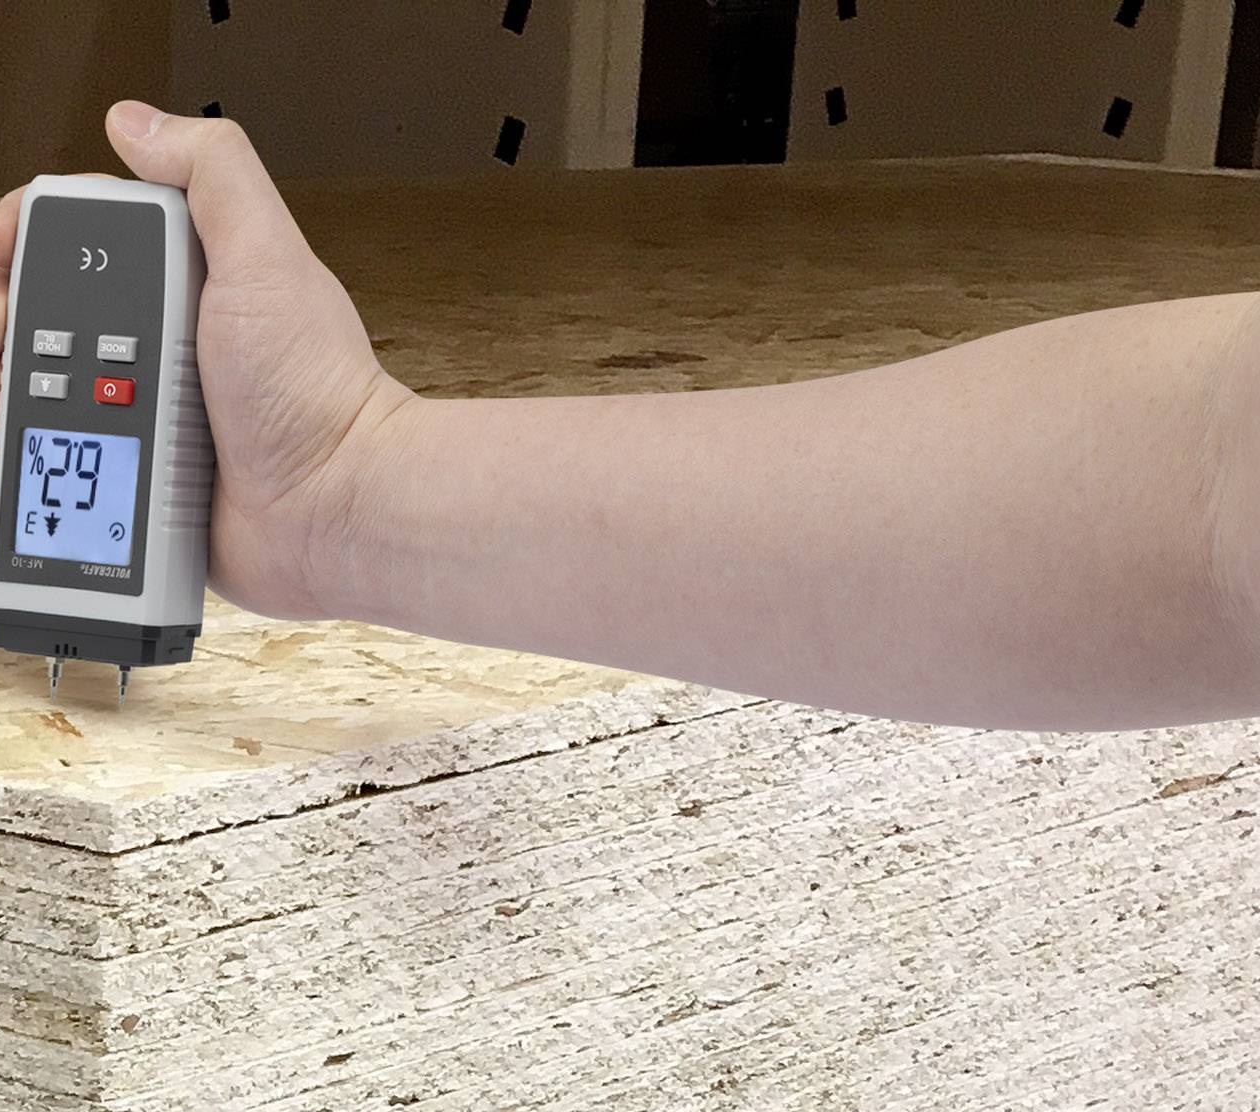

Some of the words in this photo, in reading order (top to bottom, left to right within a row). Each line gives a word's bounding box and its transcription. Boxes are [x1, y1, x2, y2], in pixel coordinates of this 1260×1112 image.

[37, 342, 61, 352] HOLD
[100, 343, 126, 353] MODE
[11, 557, 43, 569] MF-10
